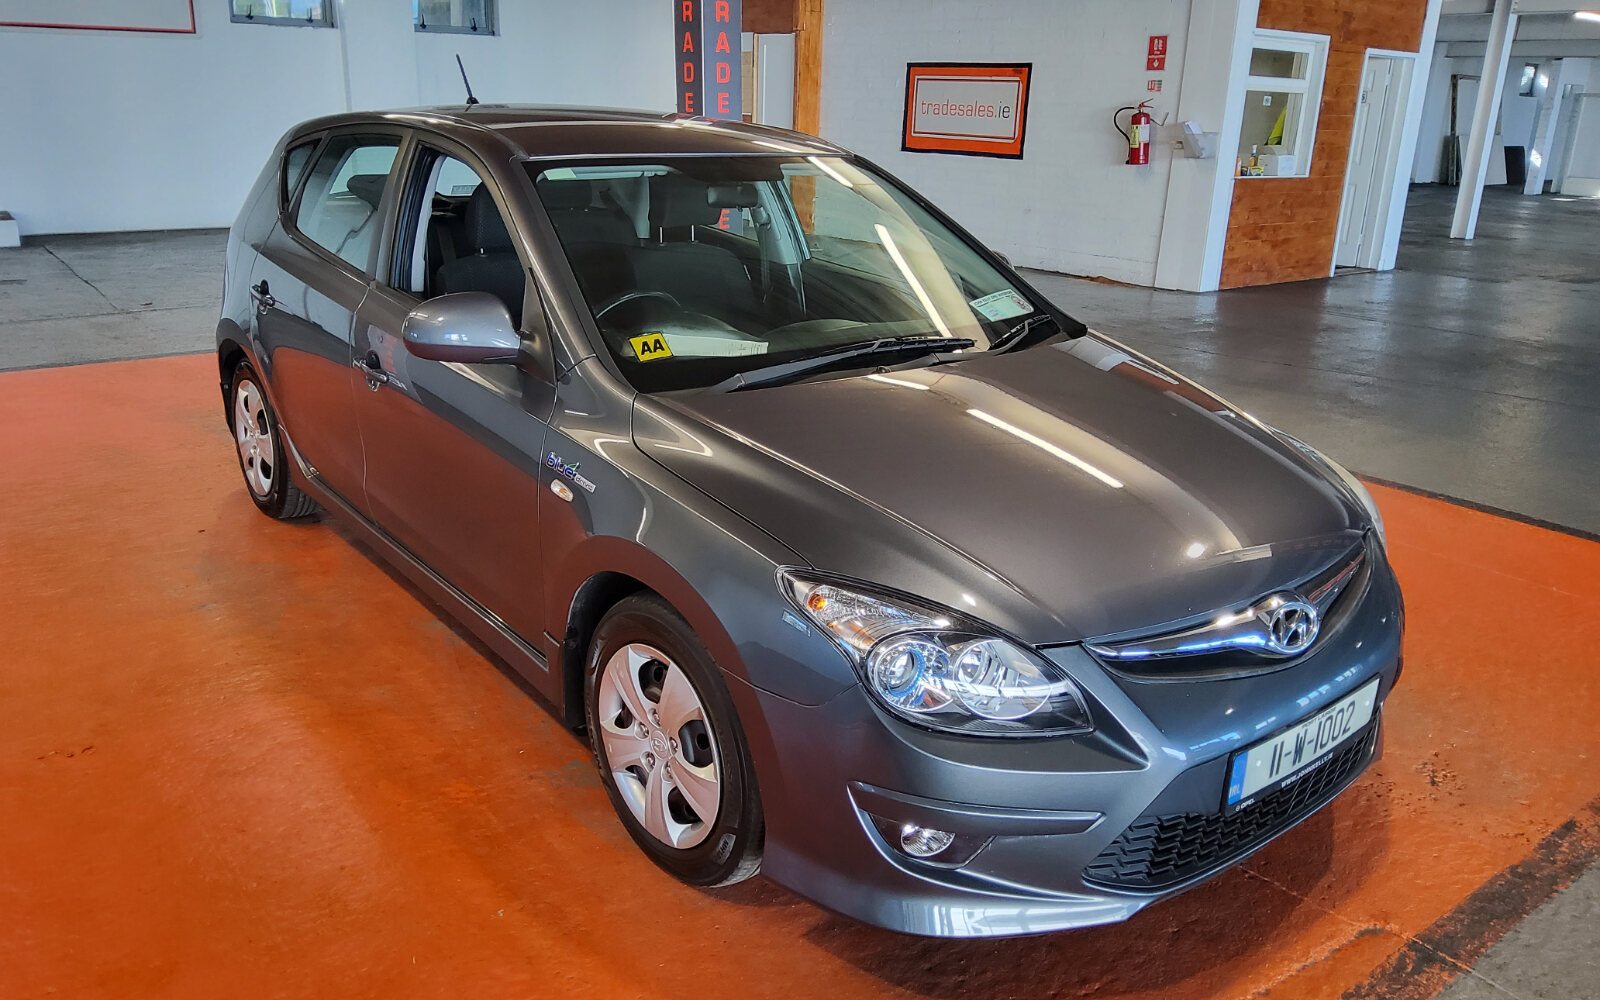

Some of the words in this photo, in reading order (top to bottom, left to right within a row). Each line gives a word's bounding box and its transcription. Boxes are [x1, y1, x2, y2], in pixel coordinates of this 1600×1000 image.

[920, 99, 1011, 119] tradesales.ie
[641, 338, 665, 355] AA
[546, 452, 575, 480] blue
[1268, 700, 1356, 779] 11-W-1002
